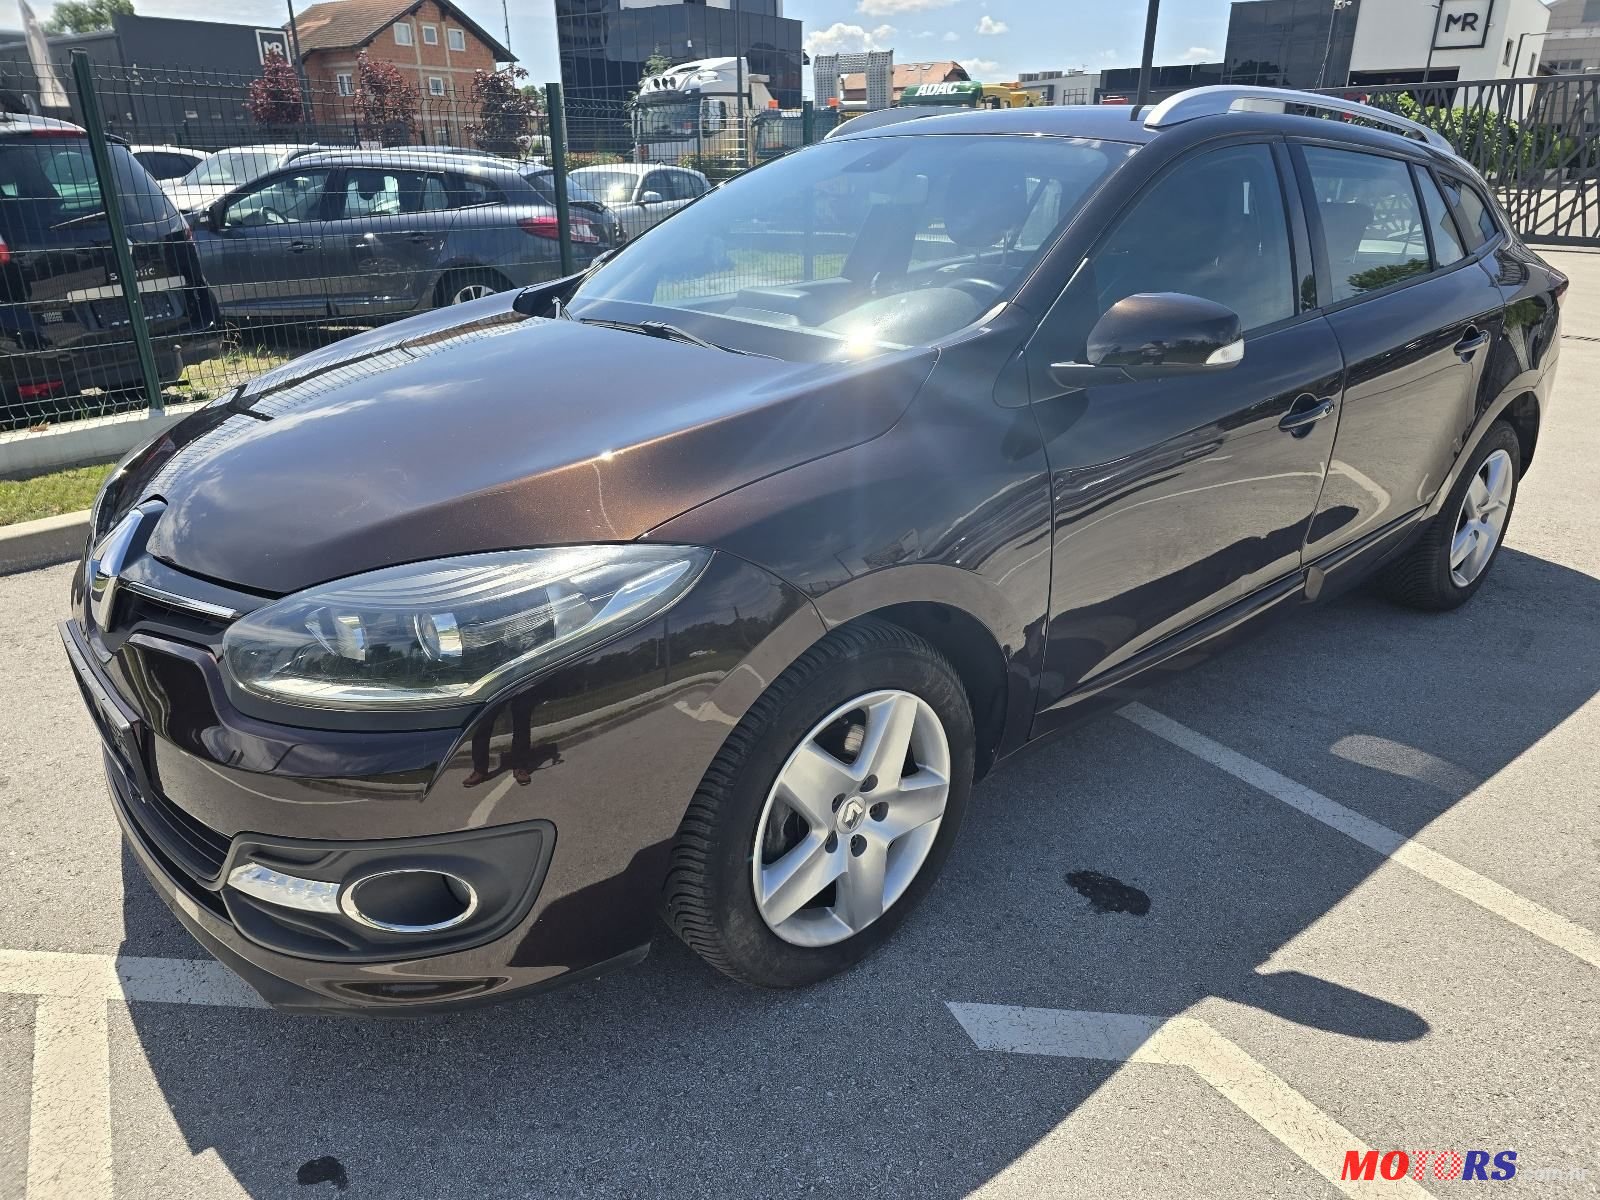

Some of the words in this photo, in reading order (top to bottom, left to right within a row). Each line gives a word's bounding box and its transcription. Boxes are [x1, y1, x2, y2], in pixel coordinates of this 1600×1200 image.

[1444, 12, 1479, 33] MR
[263, 41, 284, 56] MR
[914, 81, 959, 97] ADAC
